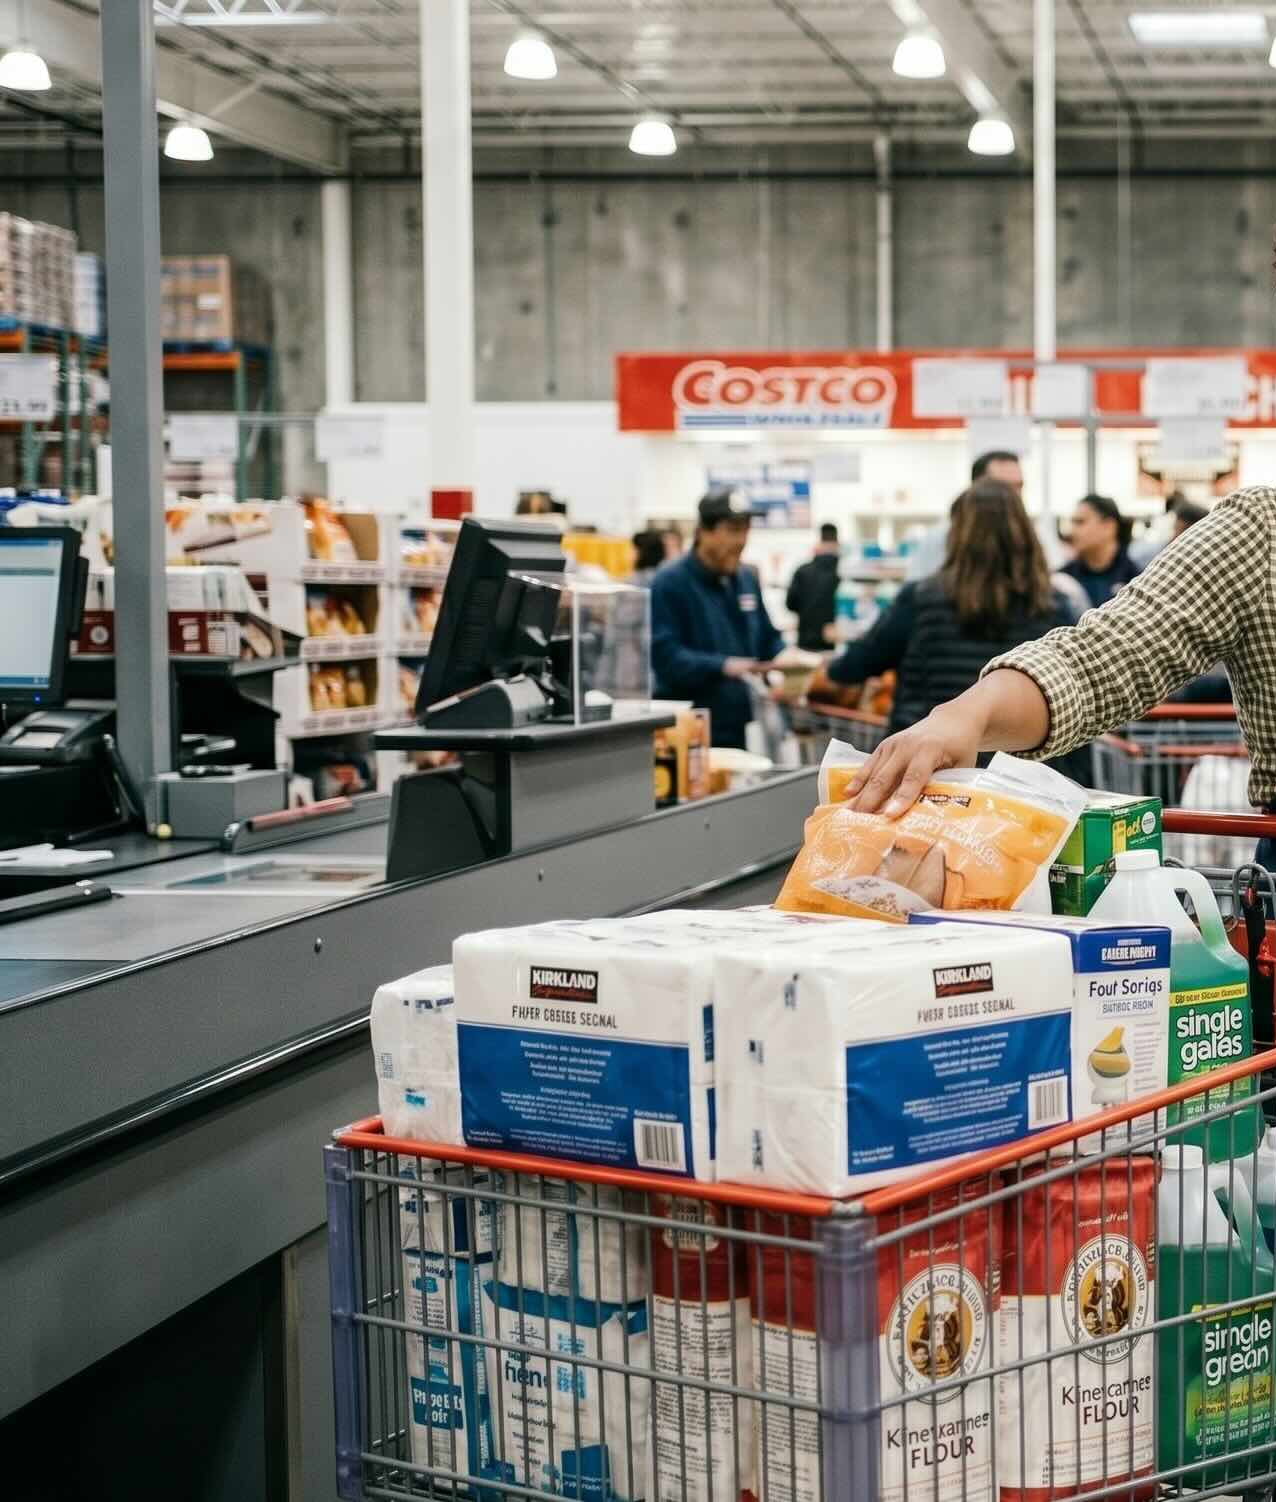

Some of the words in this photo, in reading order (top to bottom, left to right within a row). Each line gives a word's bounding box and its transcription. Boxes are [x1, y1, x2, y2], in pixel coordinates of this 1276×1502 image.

[682, 370, 886, 405] COSTCO
[532, 969, 597, 990] KIRKLAND
[935, 966, 992, 986] KIRKLAND
[1176, 1005, 1243, 1040] single
[1083, 1396, 1140, 1425] FLOUR
[911, 1435, 975, 1468] FLOUR
